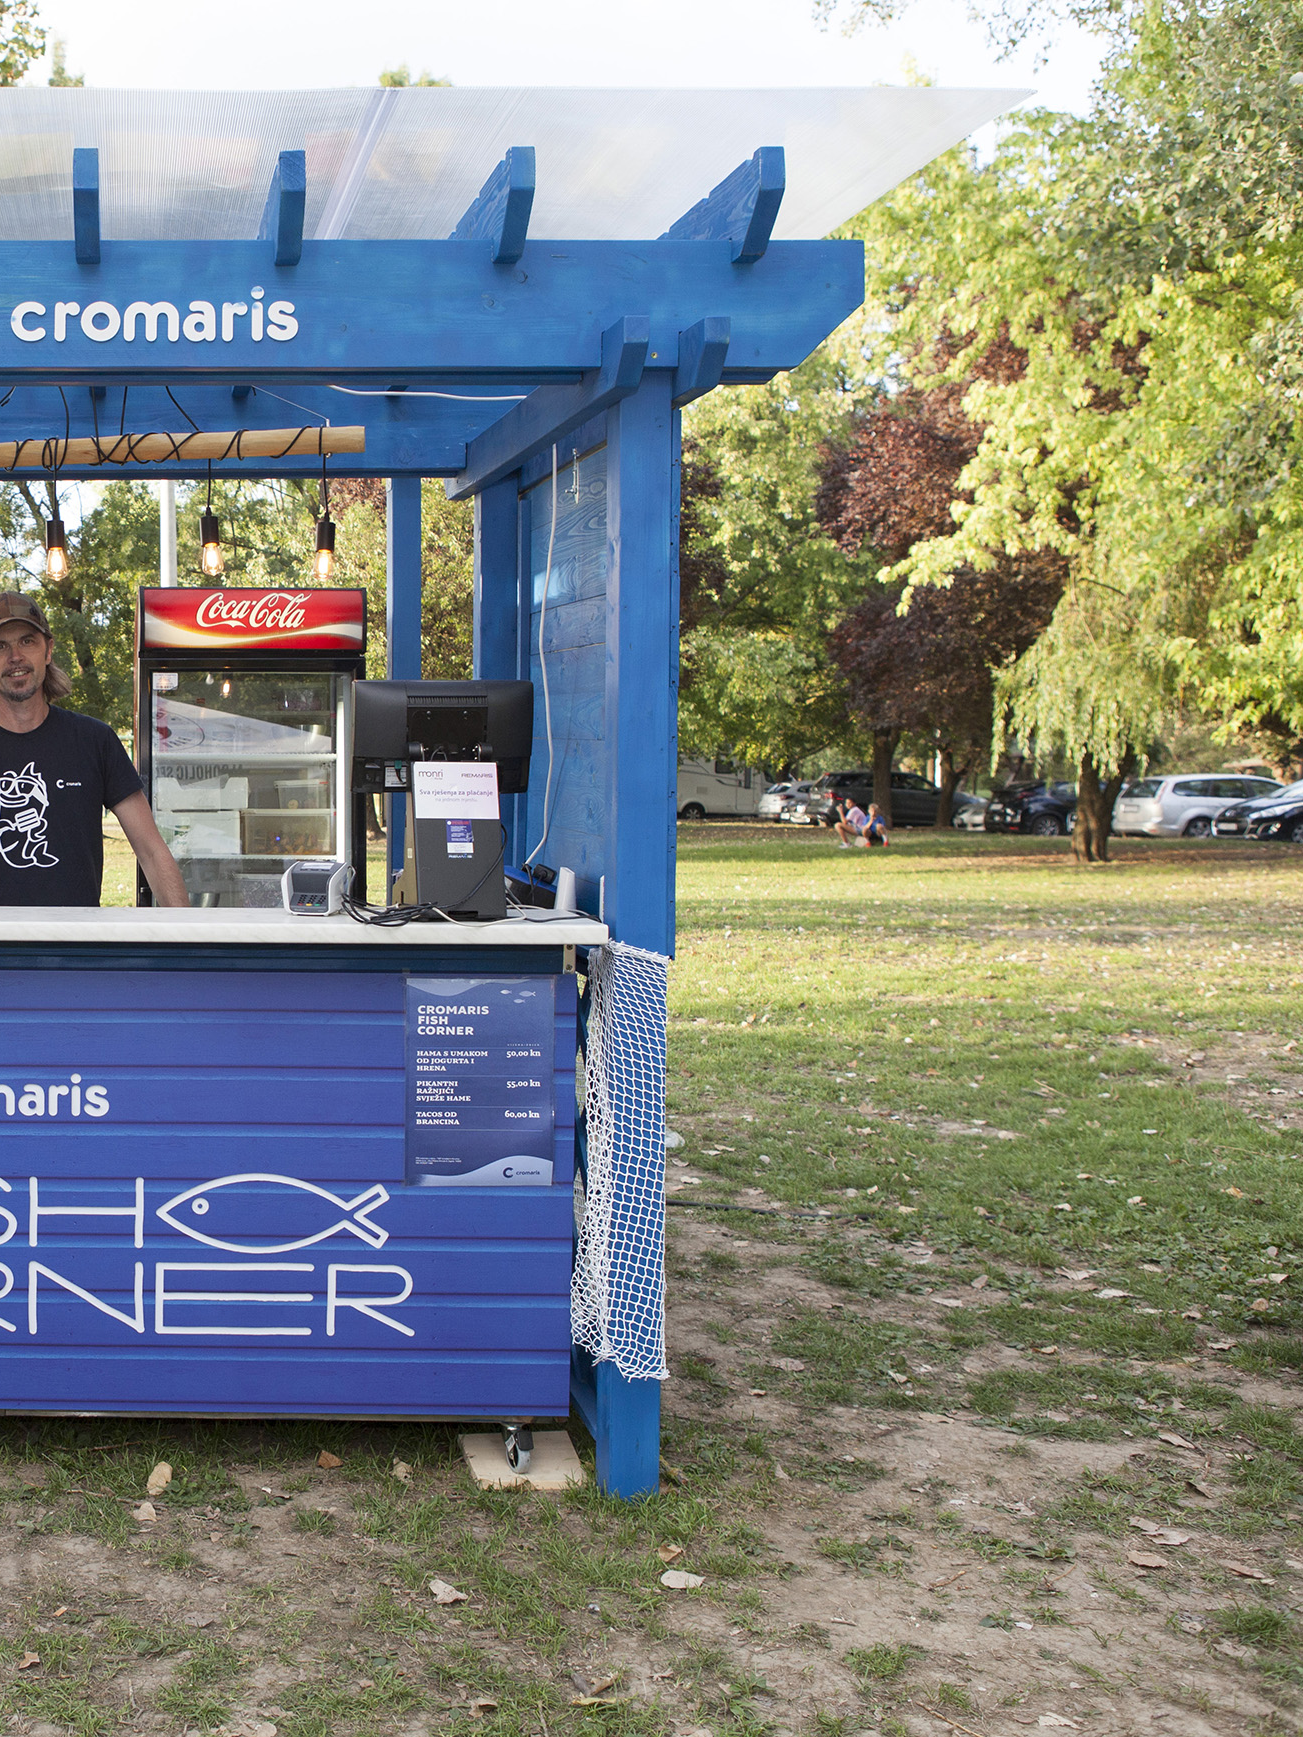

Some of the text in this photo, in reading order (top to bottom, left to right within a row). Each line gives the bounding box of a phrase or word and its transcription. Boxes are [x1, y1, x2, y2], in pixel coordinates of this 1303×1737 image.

[10, 286, 299, 342] cromaris
[196, 592, 312, 628] Coca-Cola
[417, 1005, 490, 1015] CROMARIS
[418, 1015, 448, 1025] FISH
[417, 1026, 474, 1036] CORNER
[530, 1049, 541, 1057] kn
[530, 1079, 541, 1087] kn
[416, 1086, 454, 1094] RAŽNJIĆI
[416, 1094, 445, 1102] SVJEŽE
[504, 1110, 540, 1119] 60,00 kn
